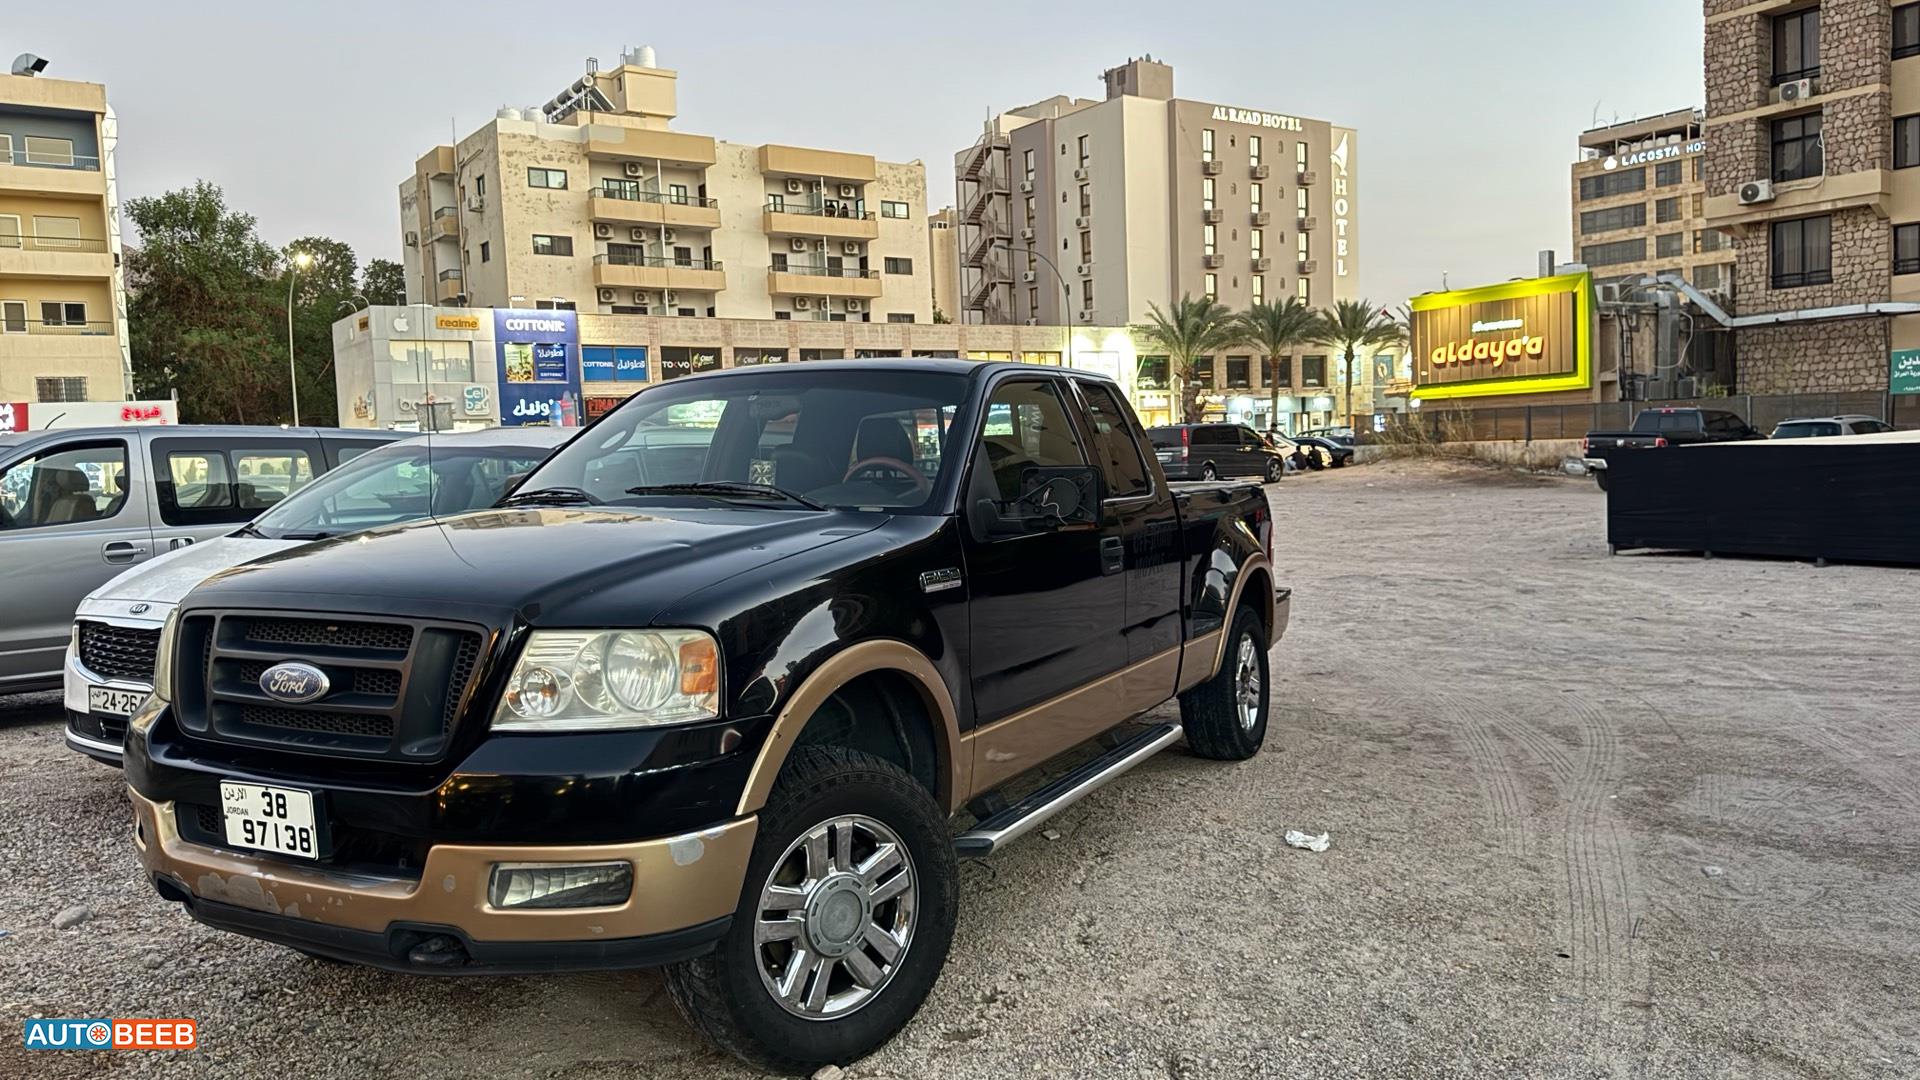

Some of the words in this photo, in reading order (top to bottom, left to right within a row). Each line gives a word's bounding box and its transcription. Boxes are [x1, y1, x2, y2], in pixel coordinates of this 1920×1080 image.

[1212, 106, 1228, 122] AL
[1262, 114, 1302, 132] HOTEL
[1621, 147, 1680, 166] LACOSTA
[1334, 178, 1349, 277] HOTEL
[439, 318, 477, 328] realme
[131, 604, 148, 613] KIA
[270, 669, 308, 694] Ford
[226, 806, 249, 816] JORDAN
[261, 791, 287, 819] 38
[242, 818, 312, 853] 97138
